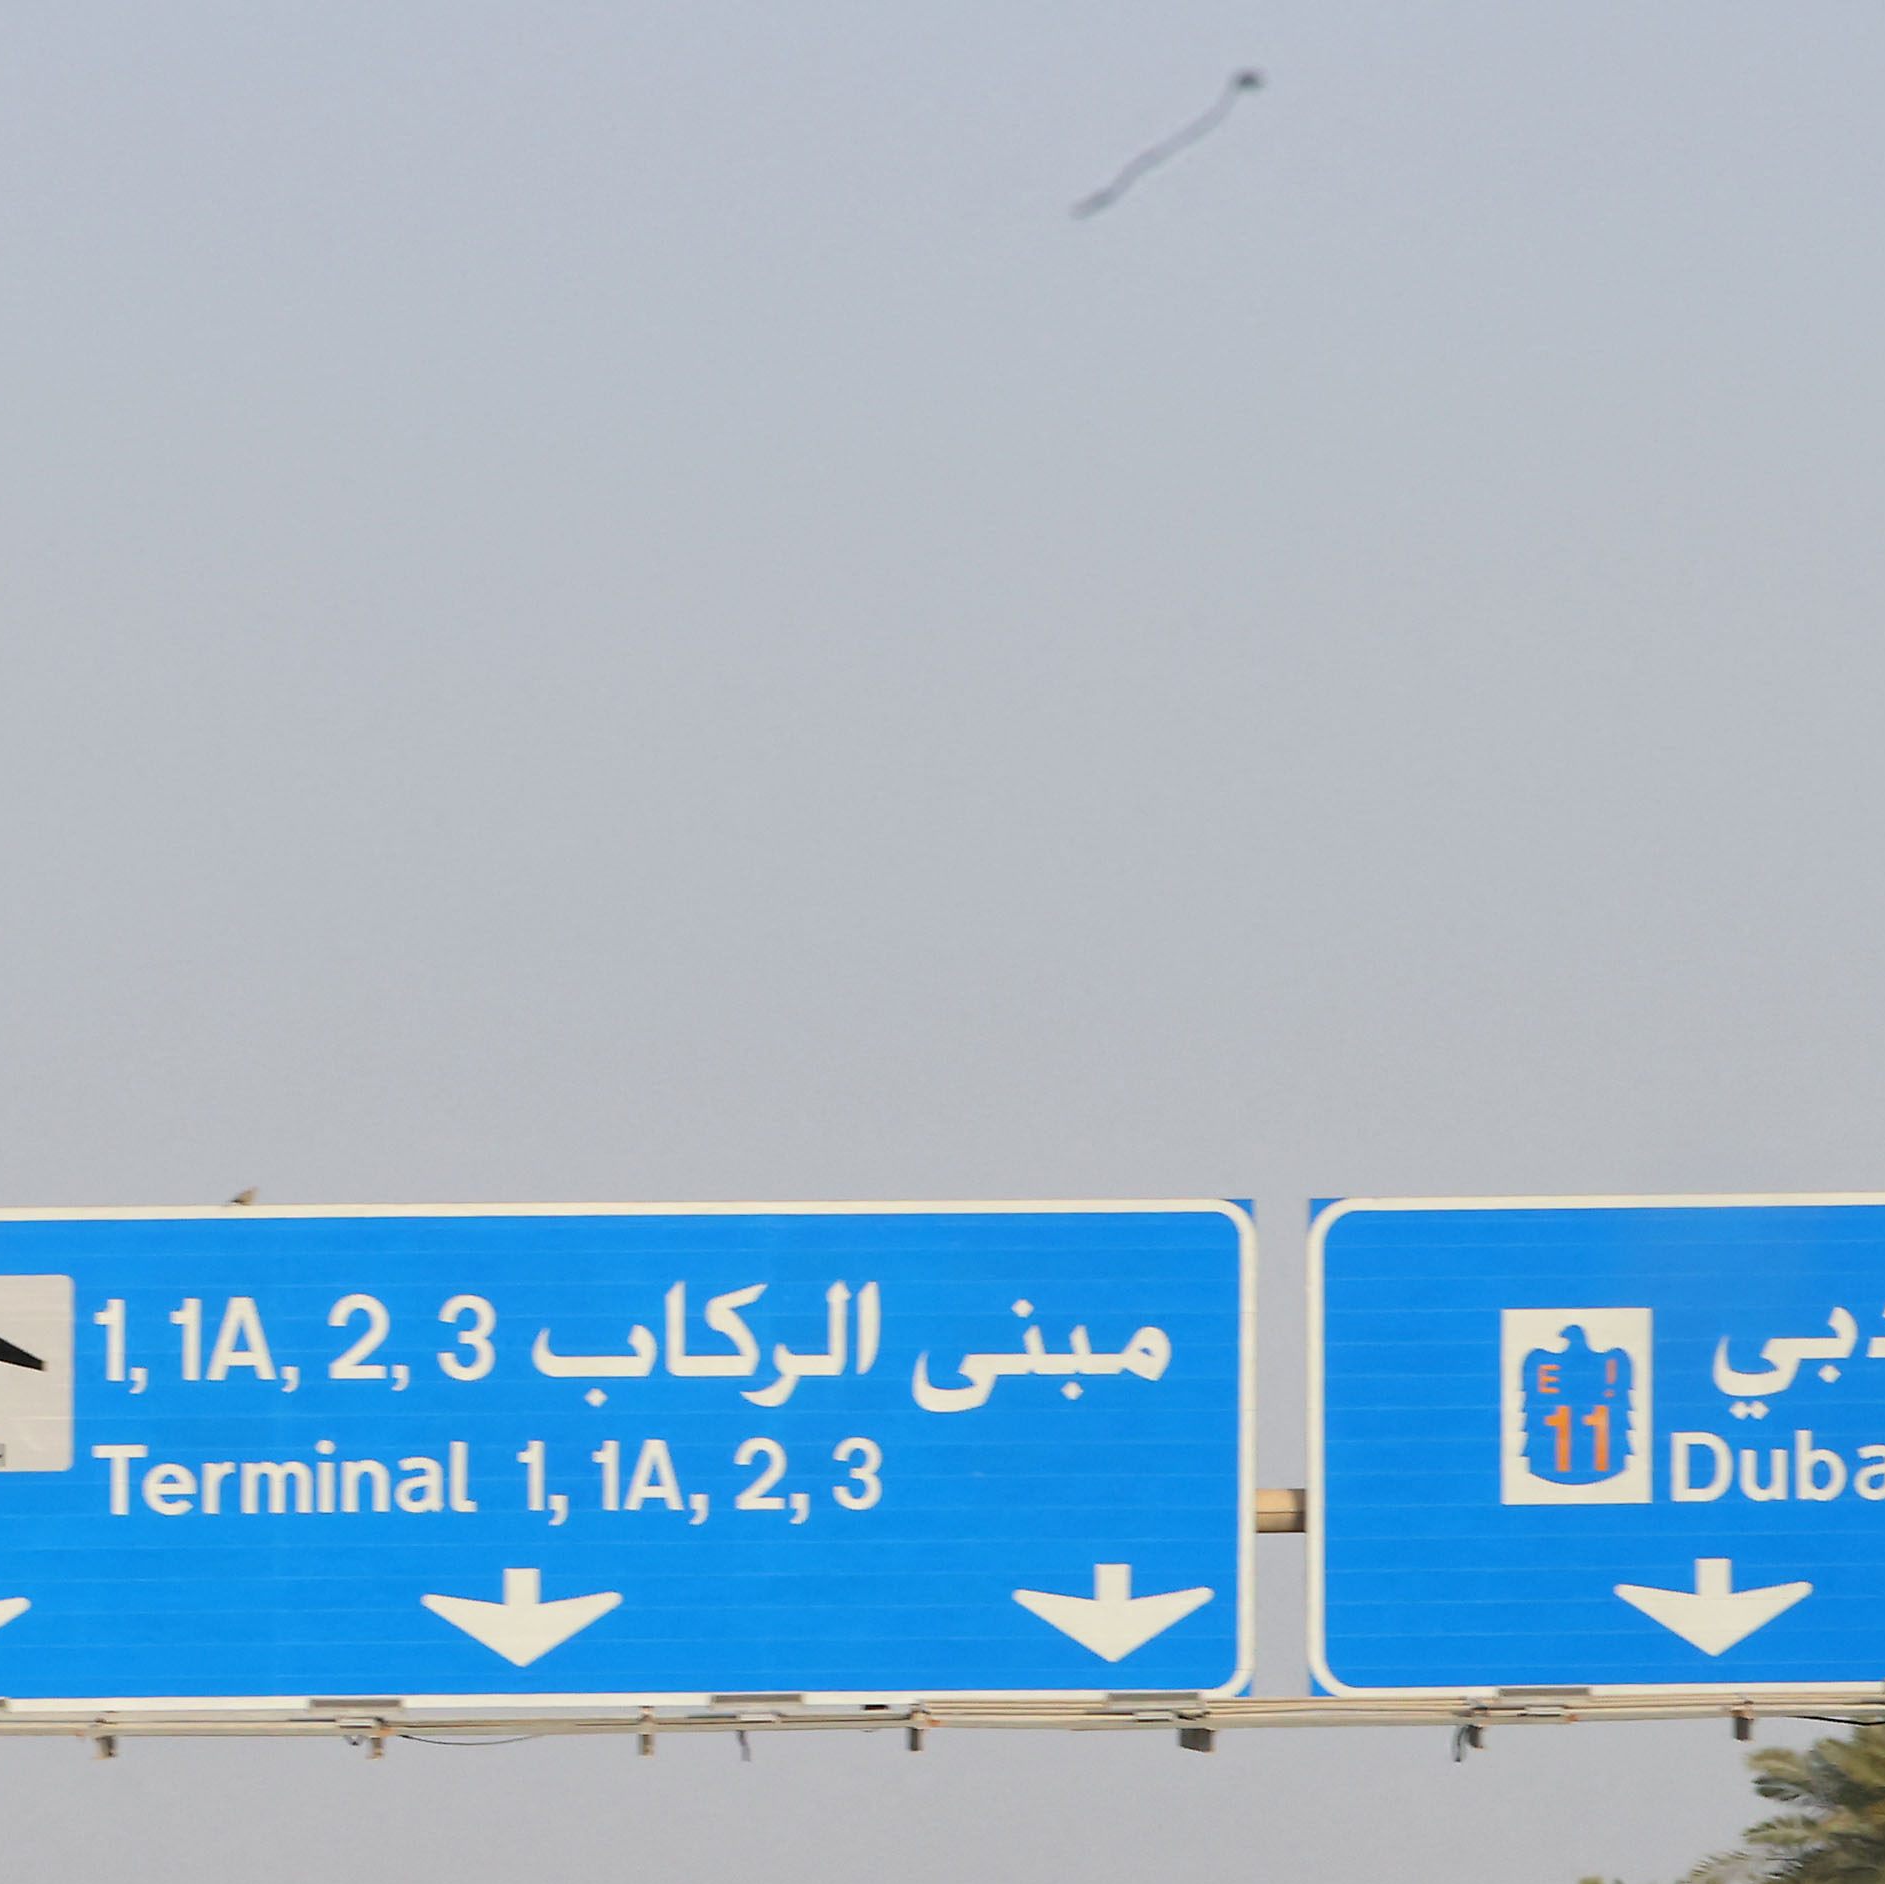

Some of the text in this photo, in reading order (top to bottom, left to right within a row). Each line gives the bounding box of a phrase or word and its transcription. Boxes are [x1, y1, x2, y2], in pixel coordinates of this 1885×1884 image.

[327, 1293, 410, 1393] 2,
[437, 1294, 497, 1382] 3
[531, 1280, 882, 1408] الركاب
[912, 1298, 1172, 1413] مبنى
[1537, 1363, 1561, 1394] E
[91, 1439, 478, 1516] Terminal
[733, 1436, 810, 1525] 2,
[832, 1436, 883, 1511] 3
[1544, 1404, 1611, 1473] 11
